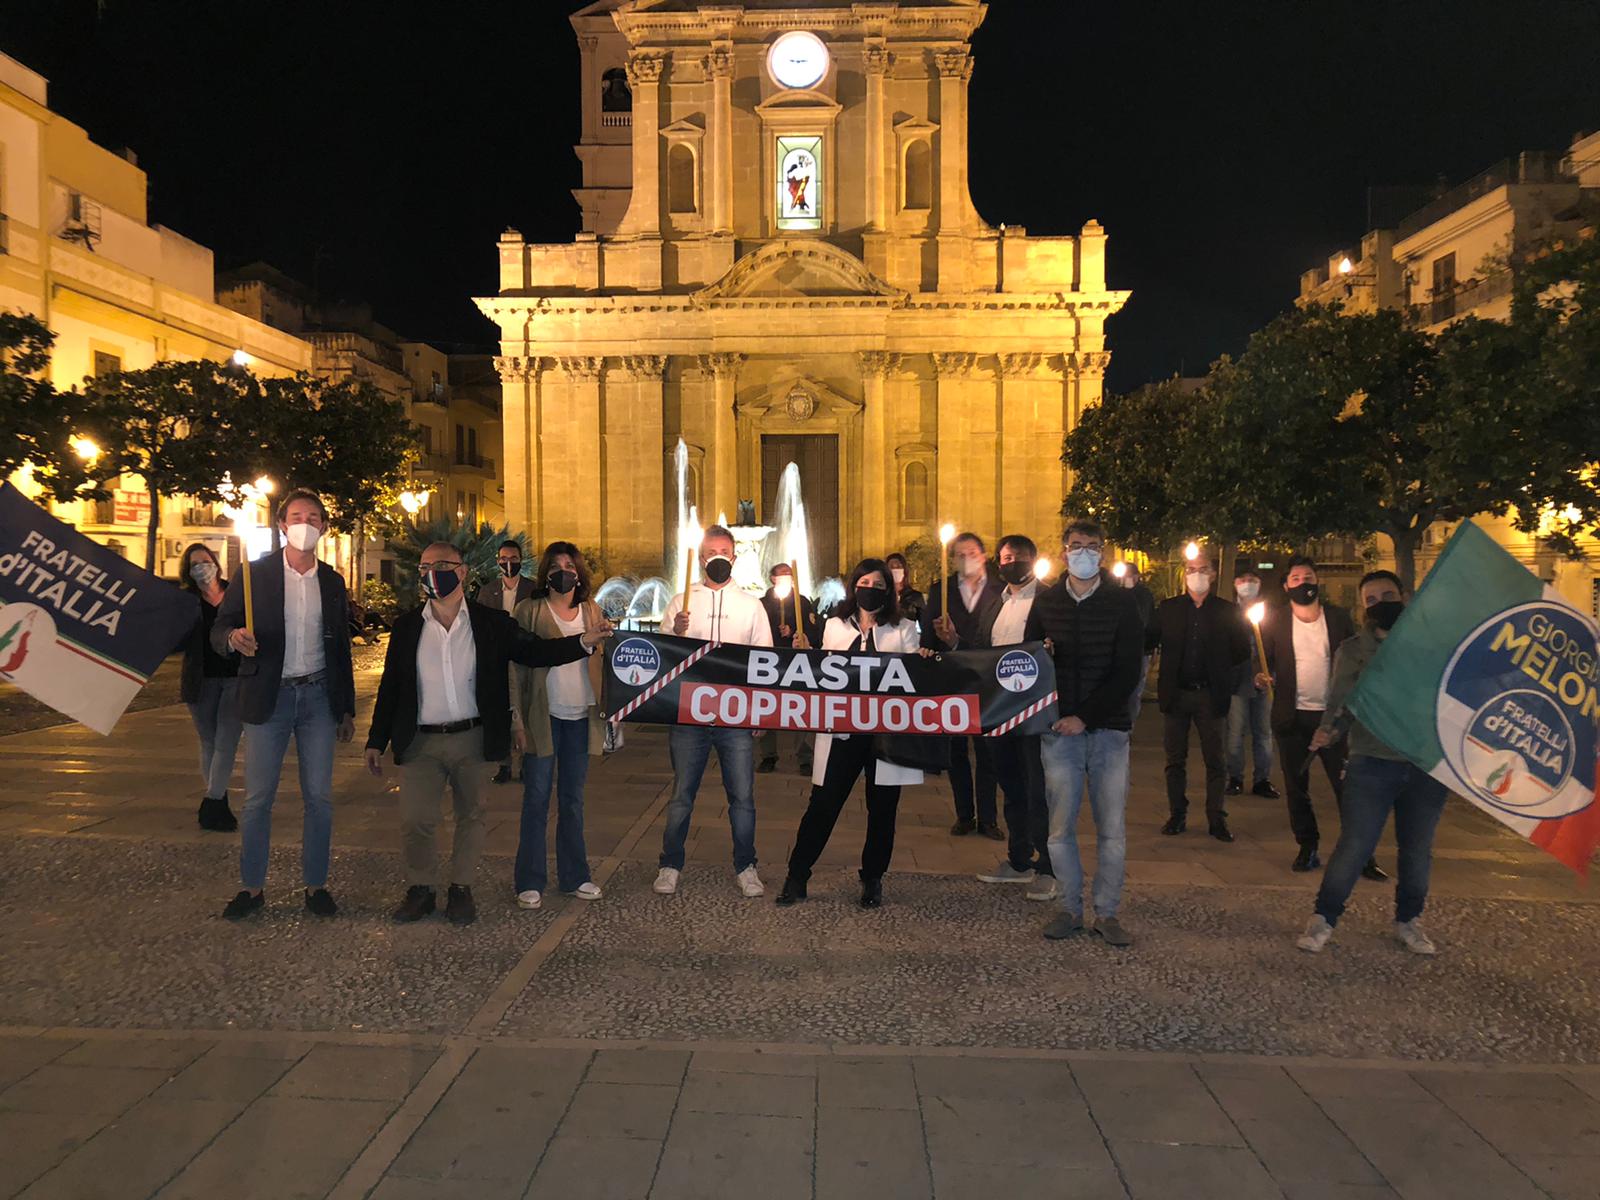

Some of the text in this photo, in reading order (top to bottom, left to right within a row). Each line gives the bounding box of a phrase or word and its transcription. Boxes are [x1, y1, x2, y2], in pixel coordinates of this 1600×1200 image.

[21, 530, 137, 606] FRATELLI
[620, 646, 654, 656] FRATELLI
[747, 650, 916, 693] BASTA
[1002, 658, 1031, 666] FRATELLI
[690, 686, 970, 733] COPRIFUOCO
[1503, 700, 1568, 752] FRATELLI
